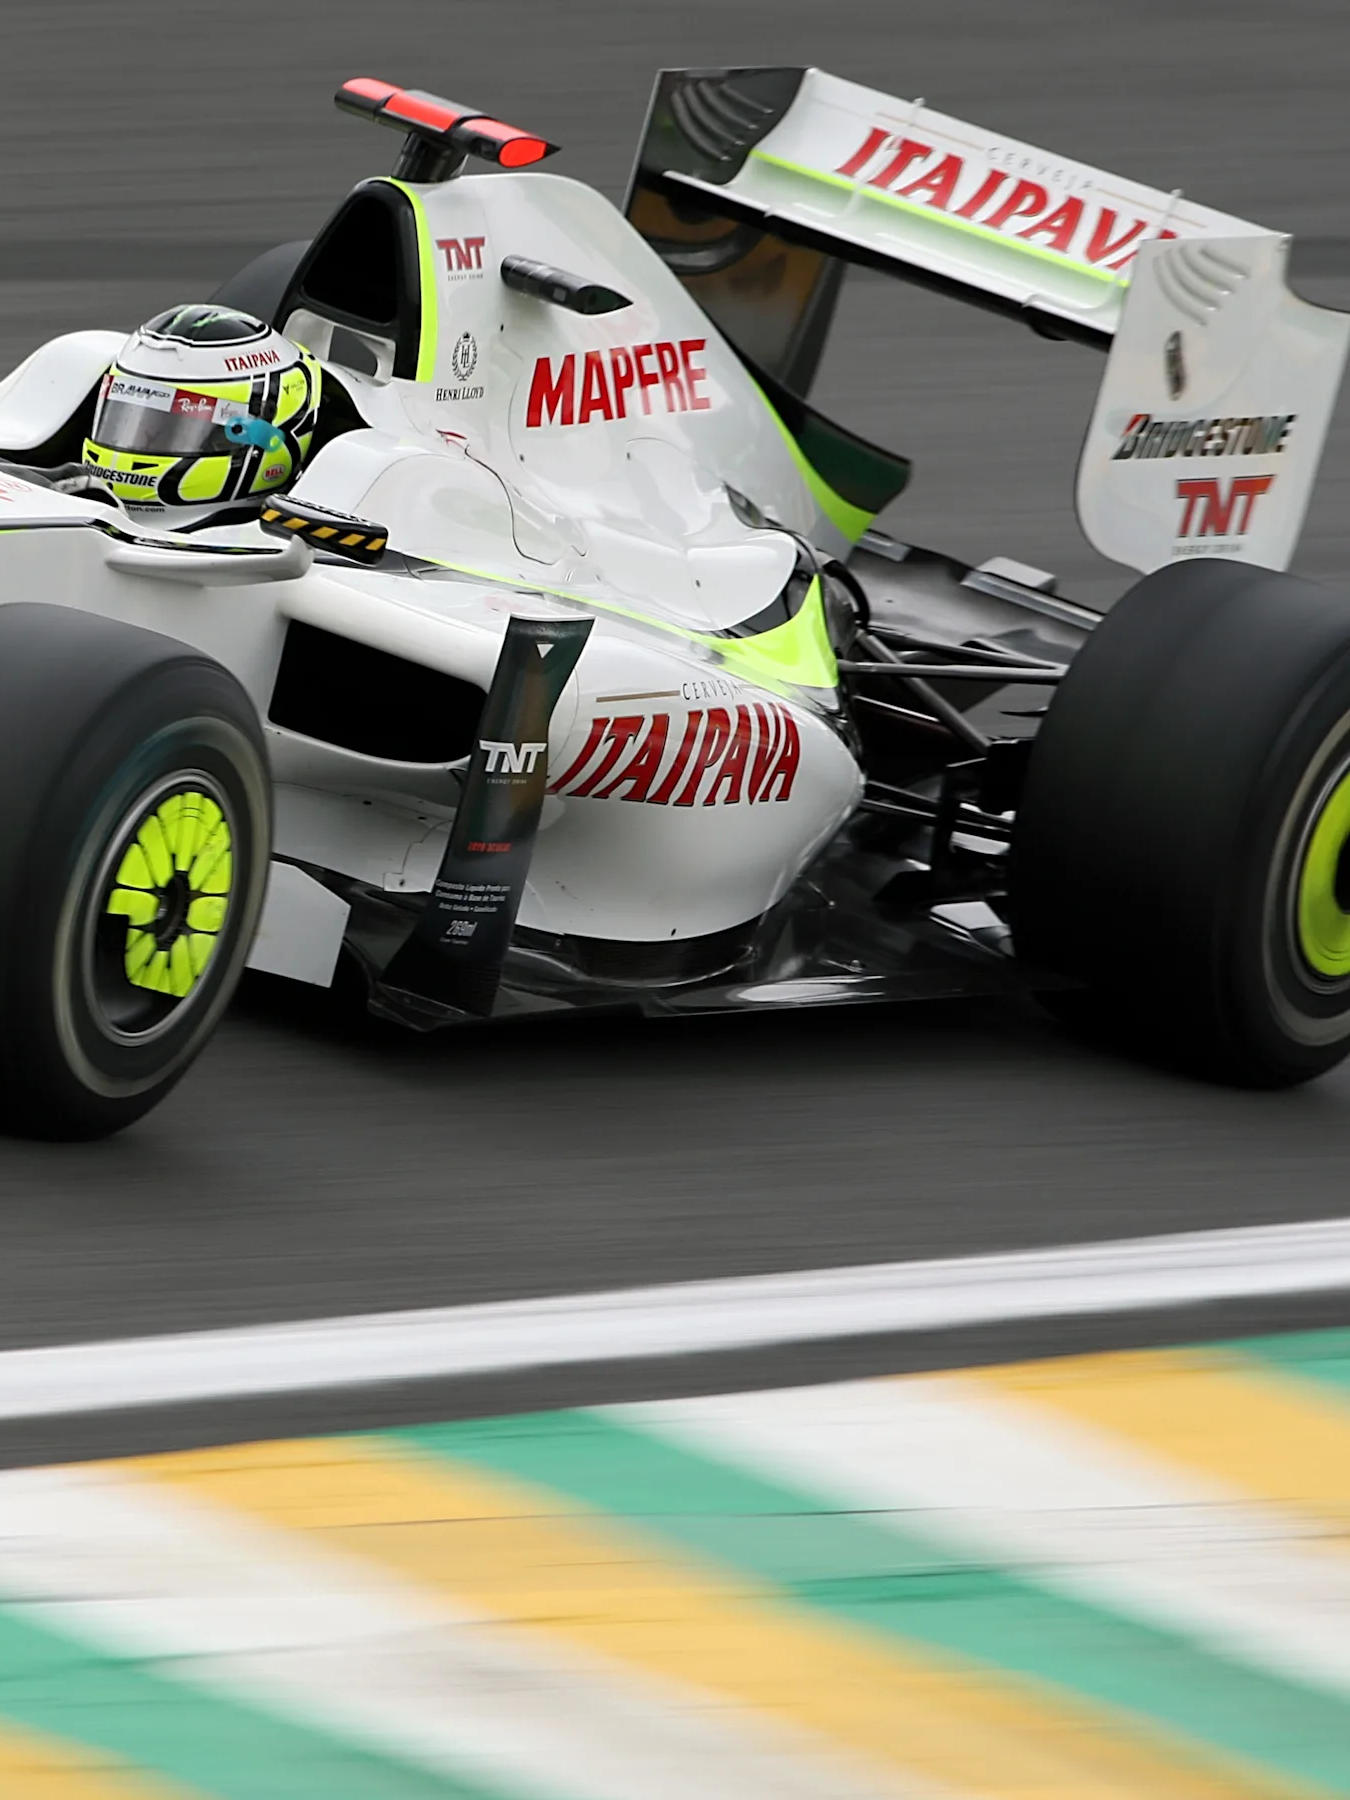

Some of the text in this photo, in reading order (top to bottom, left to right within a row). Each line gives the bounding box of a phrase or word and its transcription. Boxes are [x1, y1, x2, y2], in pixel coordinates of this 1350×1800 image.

[435, 236, 486, 272] TNT
[223, 349, 282, 373] ITAIPAVA
[435, 386, 485, 402] HENRI LLOYD
[525, 338, 712, 429] MAPFRE
[1109, 413, 1297, 460] BRIDGESTONE
[1174, 474, 1278, 538] TNT
[681, 678, 743, 701] CERVEJA
[478, 739, 548, 774] TNT
[544, 702, 802, 807] ITAIPAVA
[446, 920, 478, 937] 269ml
